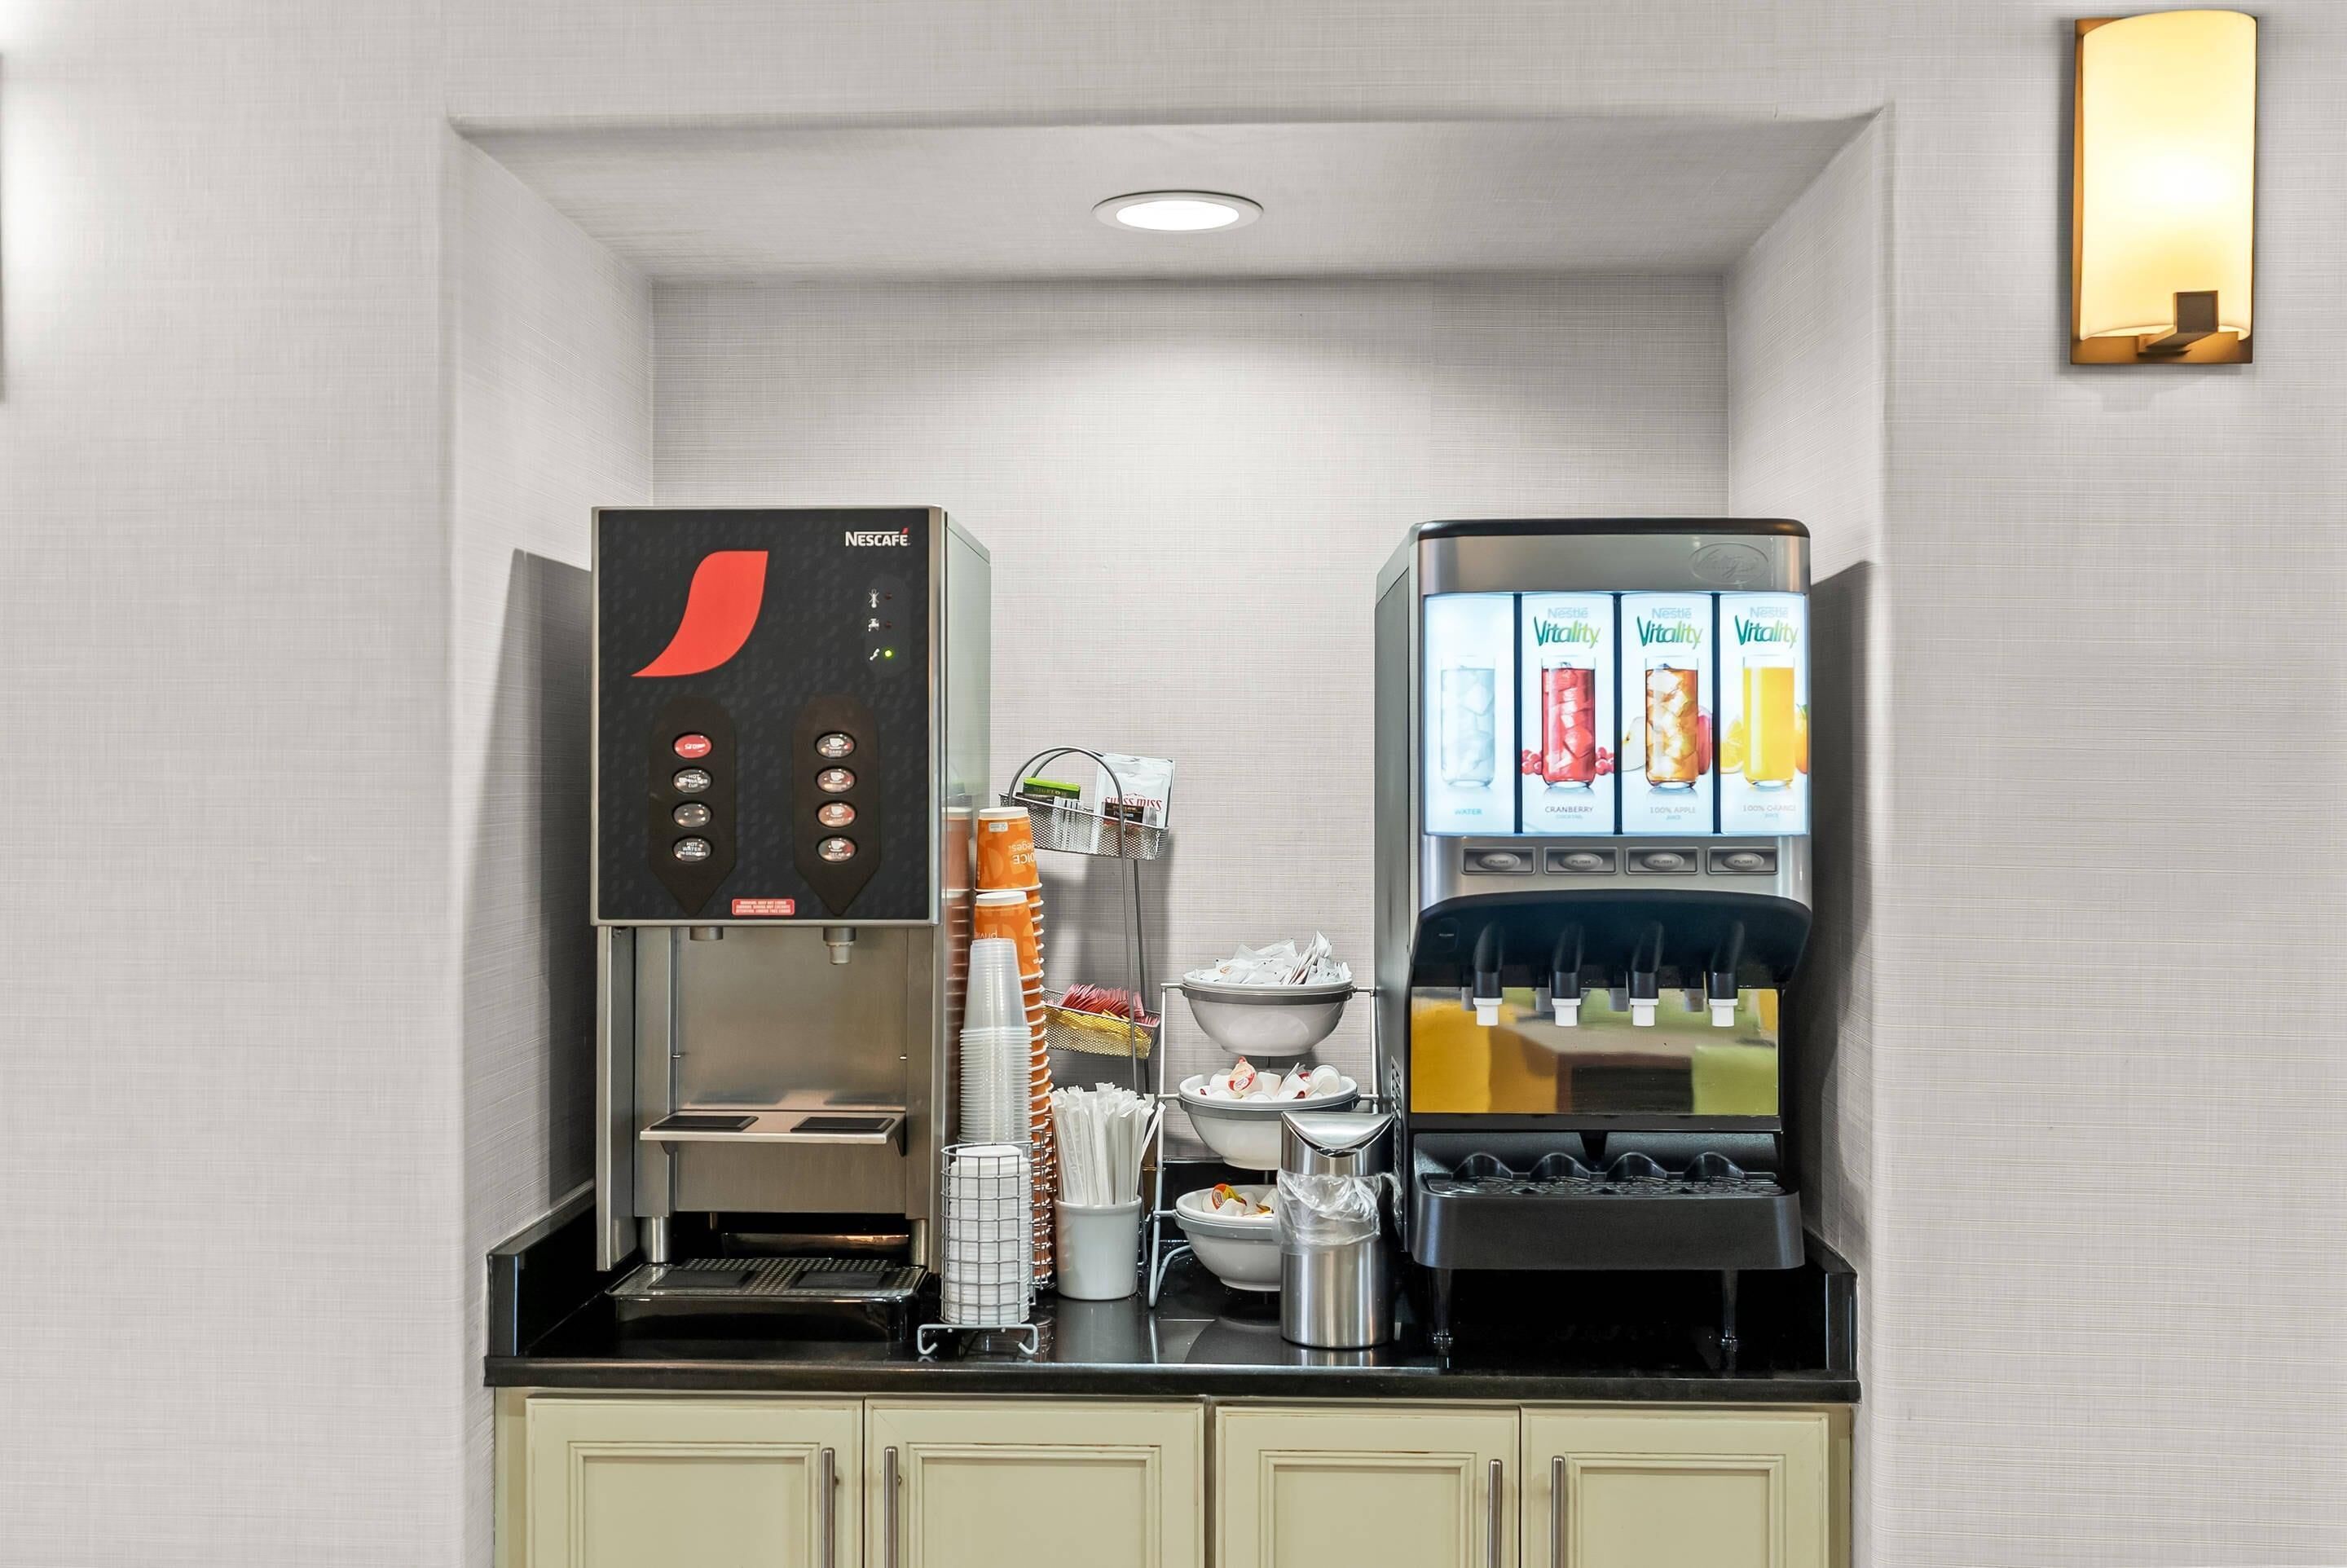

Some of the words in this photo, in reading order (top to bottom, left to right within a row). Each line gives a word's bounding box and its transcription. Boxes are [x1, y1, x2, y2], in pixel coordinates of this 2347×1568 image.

[845, 527, 909, 547] NESCAFÉ
[1534, 615, 1601, 649] Vitality
[1636, 615, 1703, 650] Vitality
[1734, 614, 1799, 649] Vitality
[1012, 852, 1035, 865] OICE
